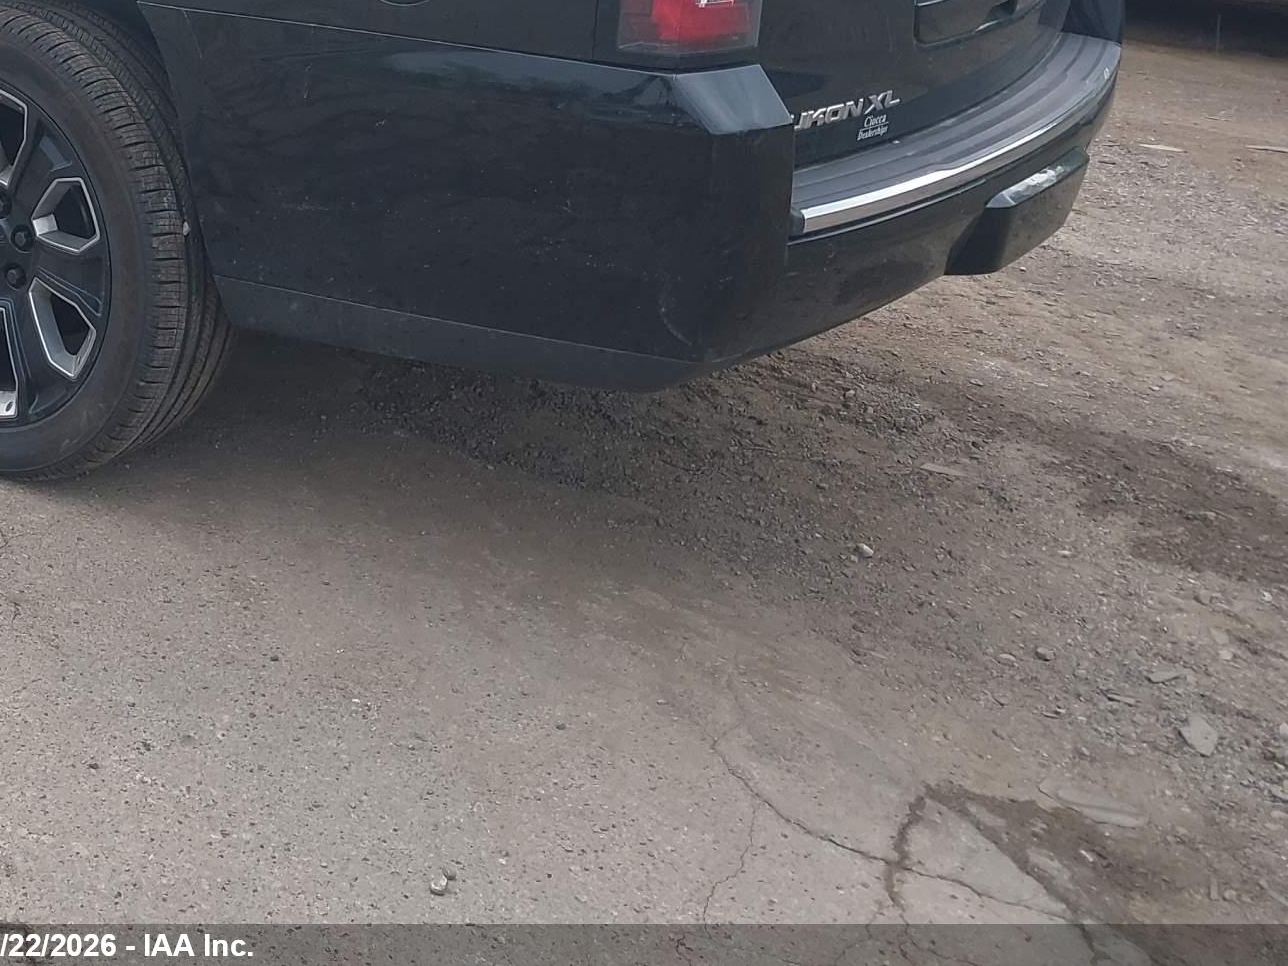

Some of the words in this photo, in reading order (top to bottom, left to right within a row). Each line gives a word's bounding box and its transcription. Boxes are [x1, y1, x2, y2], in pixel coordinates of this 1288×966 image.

[792, 97, 864, 132] UKON
[864, 89, 900, 115] XL
[856, 124, 889, 141] Dealerships
